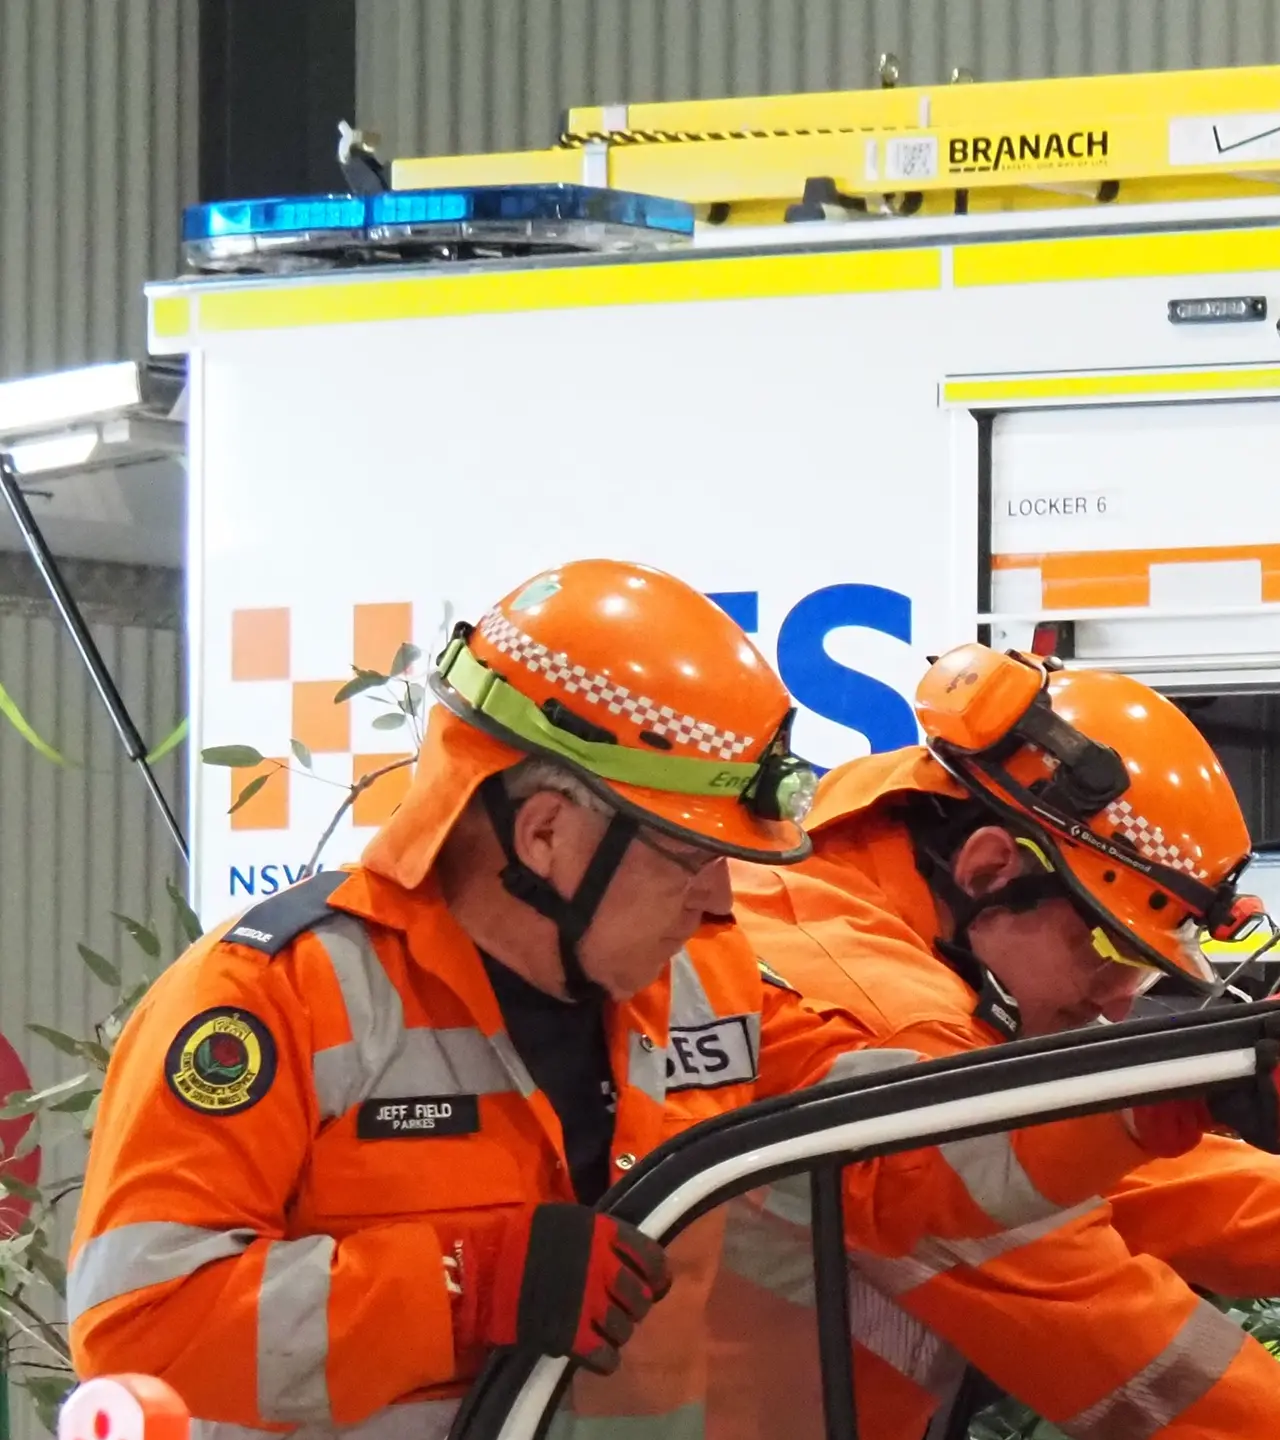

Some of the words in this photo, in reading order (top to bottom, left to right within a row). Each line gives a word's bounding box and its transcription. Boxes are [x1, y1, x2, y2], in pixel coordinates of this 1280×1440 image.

[949, 131, 1108, 169] BRANACH
[1007, 496, 1088, 517] LOCKER
[1096, 496, 1107, 514] 6
[376, 1105, 409, 1121] JEFF
[415, 1102, 453, 1119] FIELD
